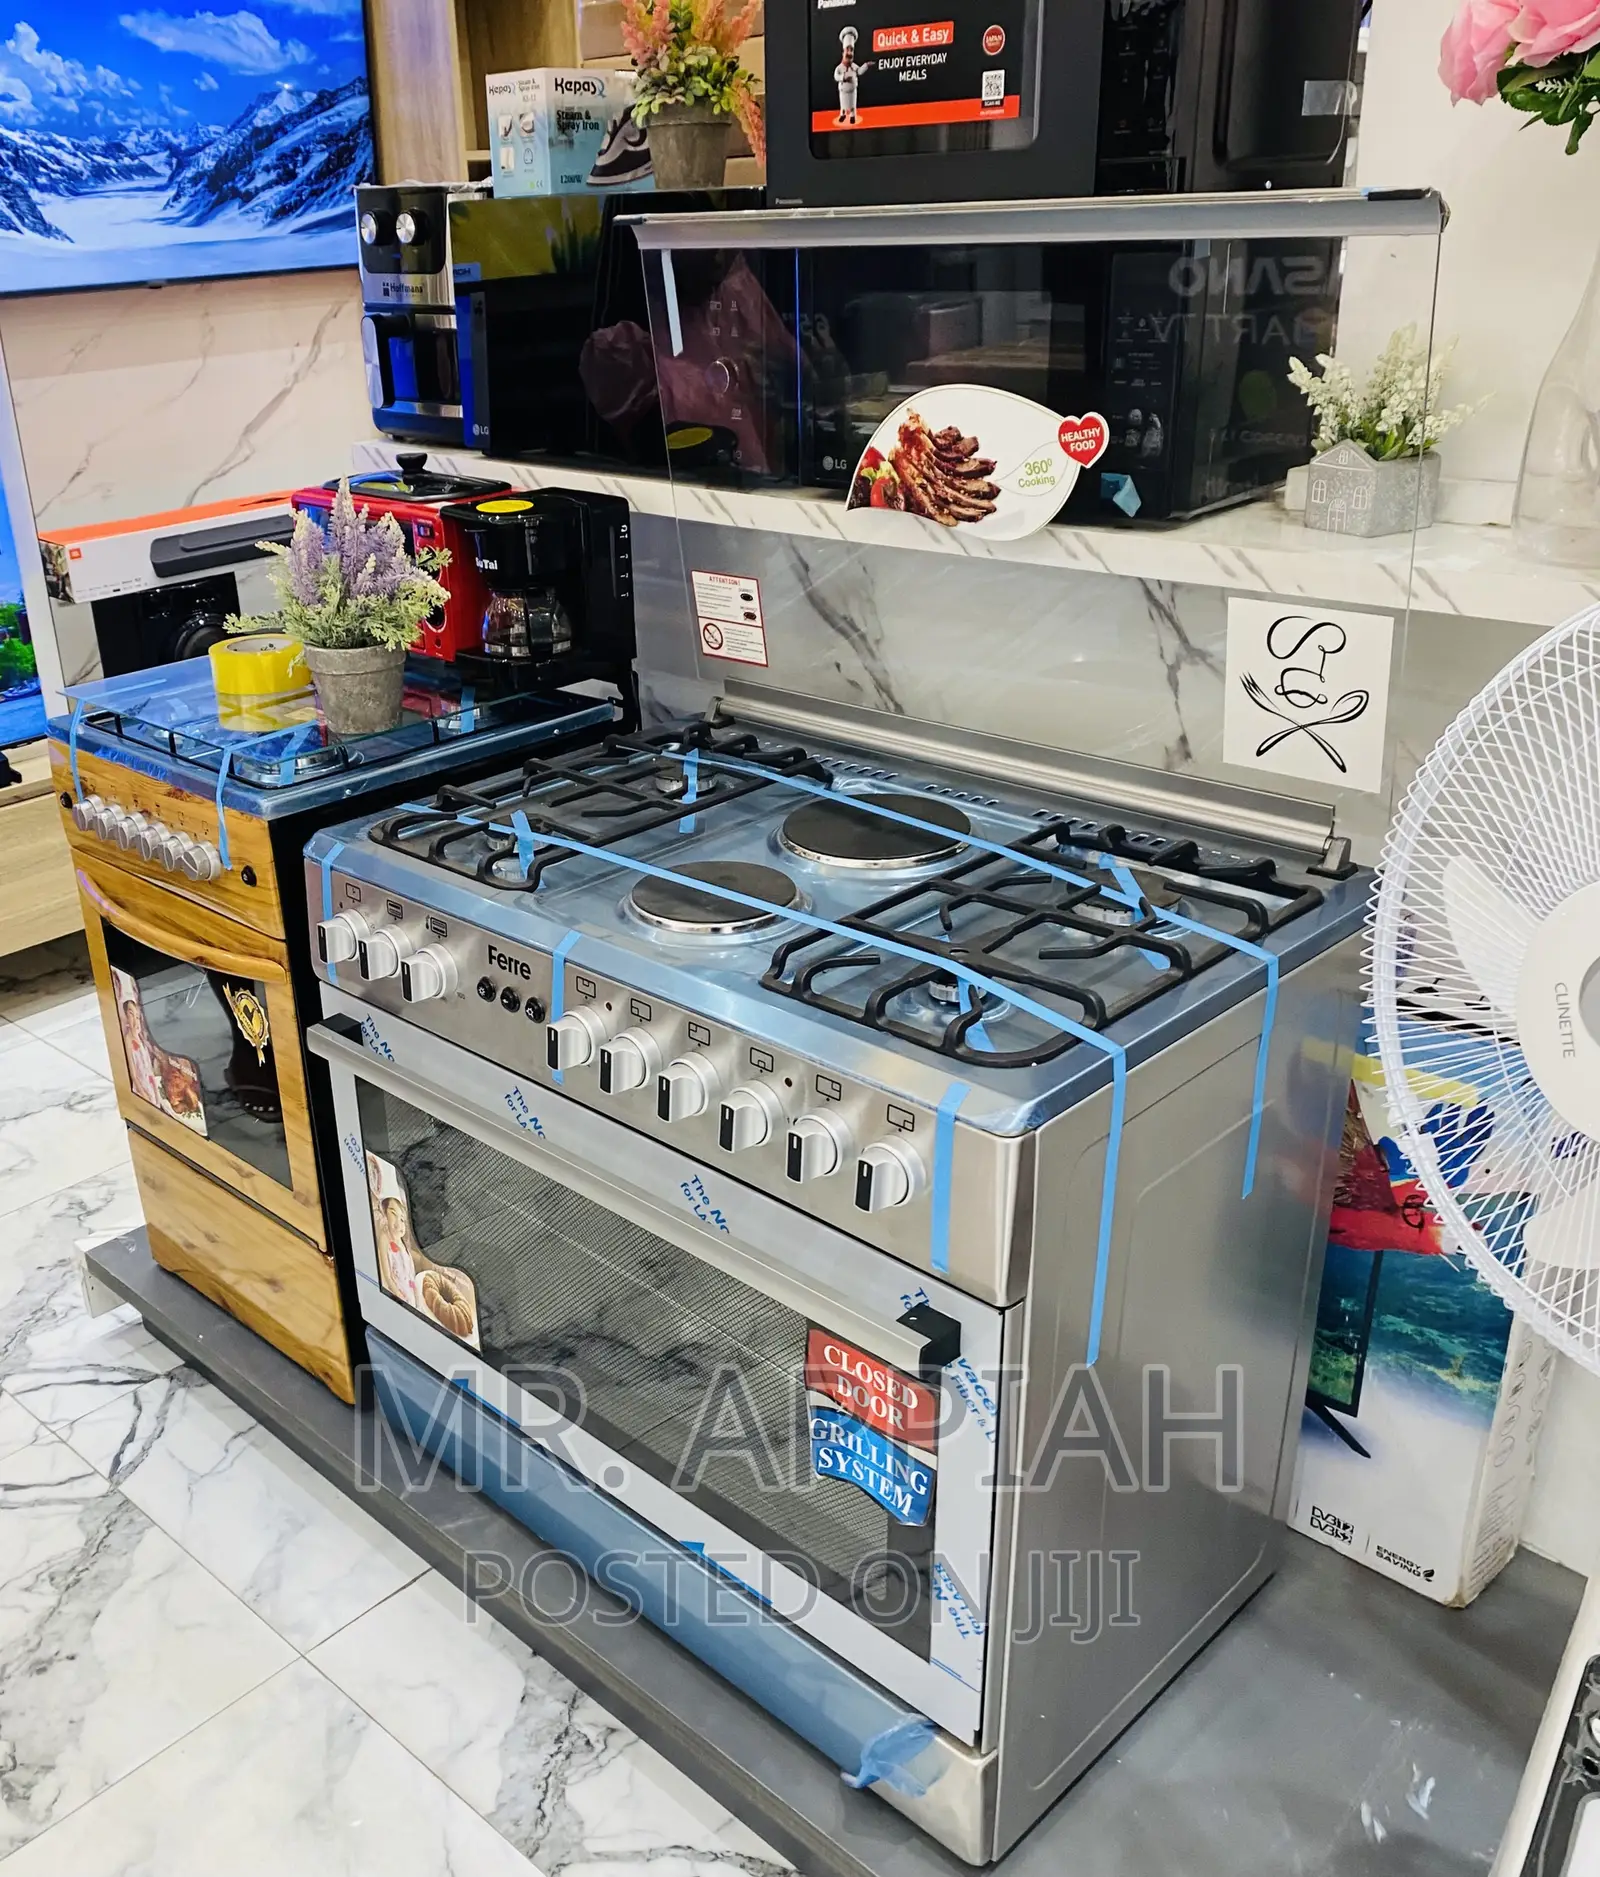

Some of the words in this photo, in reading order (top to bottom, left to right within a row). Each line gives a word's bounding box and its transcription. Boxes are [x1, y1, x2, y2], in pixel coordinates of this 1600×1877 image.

[877, 31, 906, 48] Quick
[911, 30, 919, 45] &
[922, 27, 949, 45] Easy
[878, 57, 904, 70] ENJOY
[906, 53, 948, 67] EVERYDAY
[899, 69, 927, 82] MEALS
[556, 110, 583, 120] Steam
[585, 110, 591, 119] &
[557, 121, 580, 133] Spray
[582, 121, 600, 131] Iron
[1060, 426, 1101, 443] HEALTHY
[1070, 439, 1096, 452] FOOD
[834, 459, 847, 470] LG
[1018, 474, 1056, 488] Cooking
[488, 944, 532, 980] Ferre
[365, 1013, 380, 1039] The
[1554, 982, 1576, 1058] CLINETTE
[504, 1093, 517, 1112] for
[513, 1086, 529, 1113] The
[680, 1182, 696, 1201] for
[691, 1174, 710, 1205] The
[823, 1345, 918, 1410] CLOSED
[836, 1373, 905, 1432] DOOR
[950, 1375, 980, 1415] Fiber
[810, 1418, 929, 1496] GRILLING
[817, 1447, 915, 1517] SYSTEM
[1376, 1545, 1421, 1570] ENERGY
[1376, 1551, 1421, 1577] SAVING
